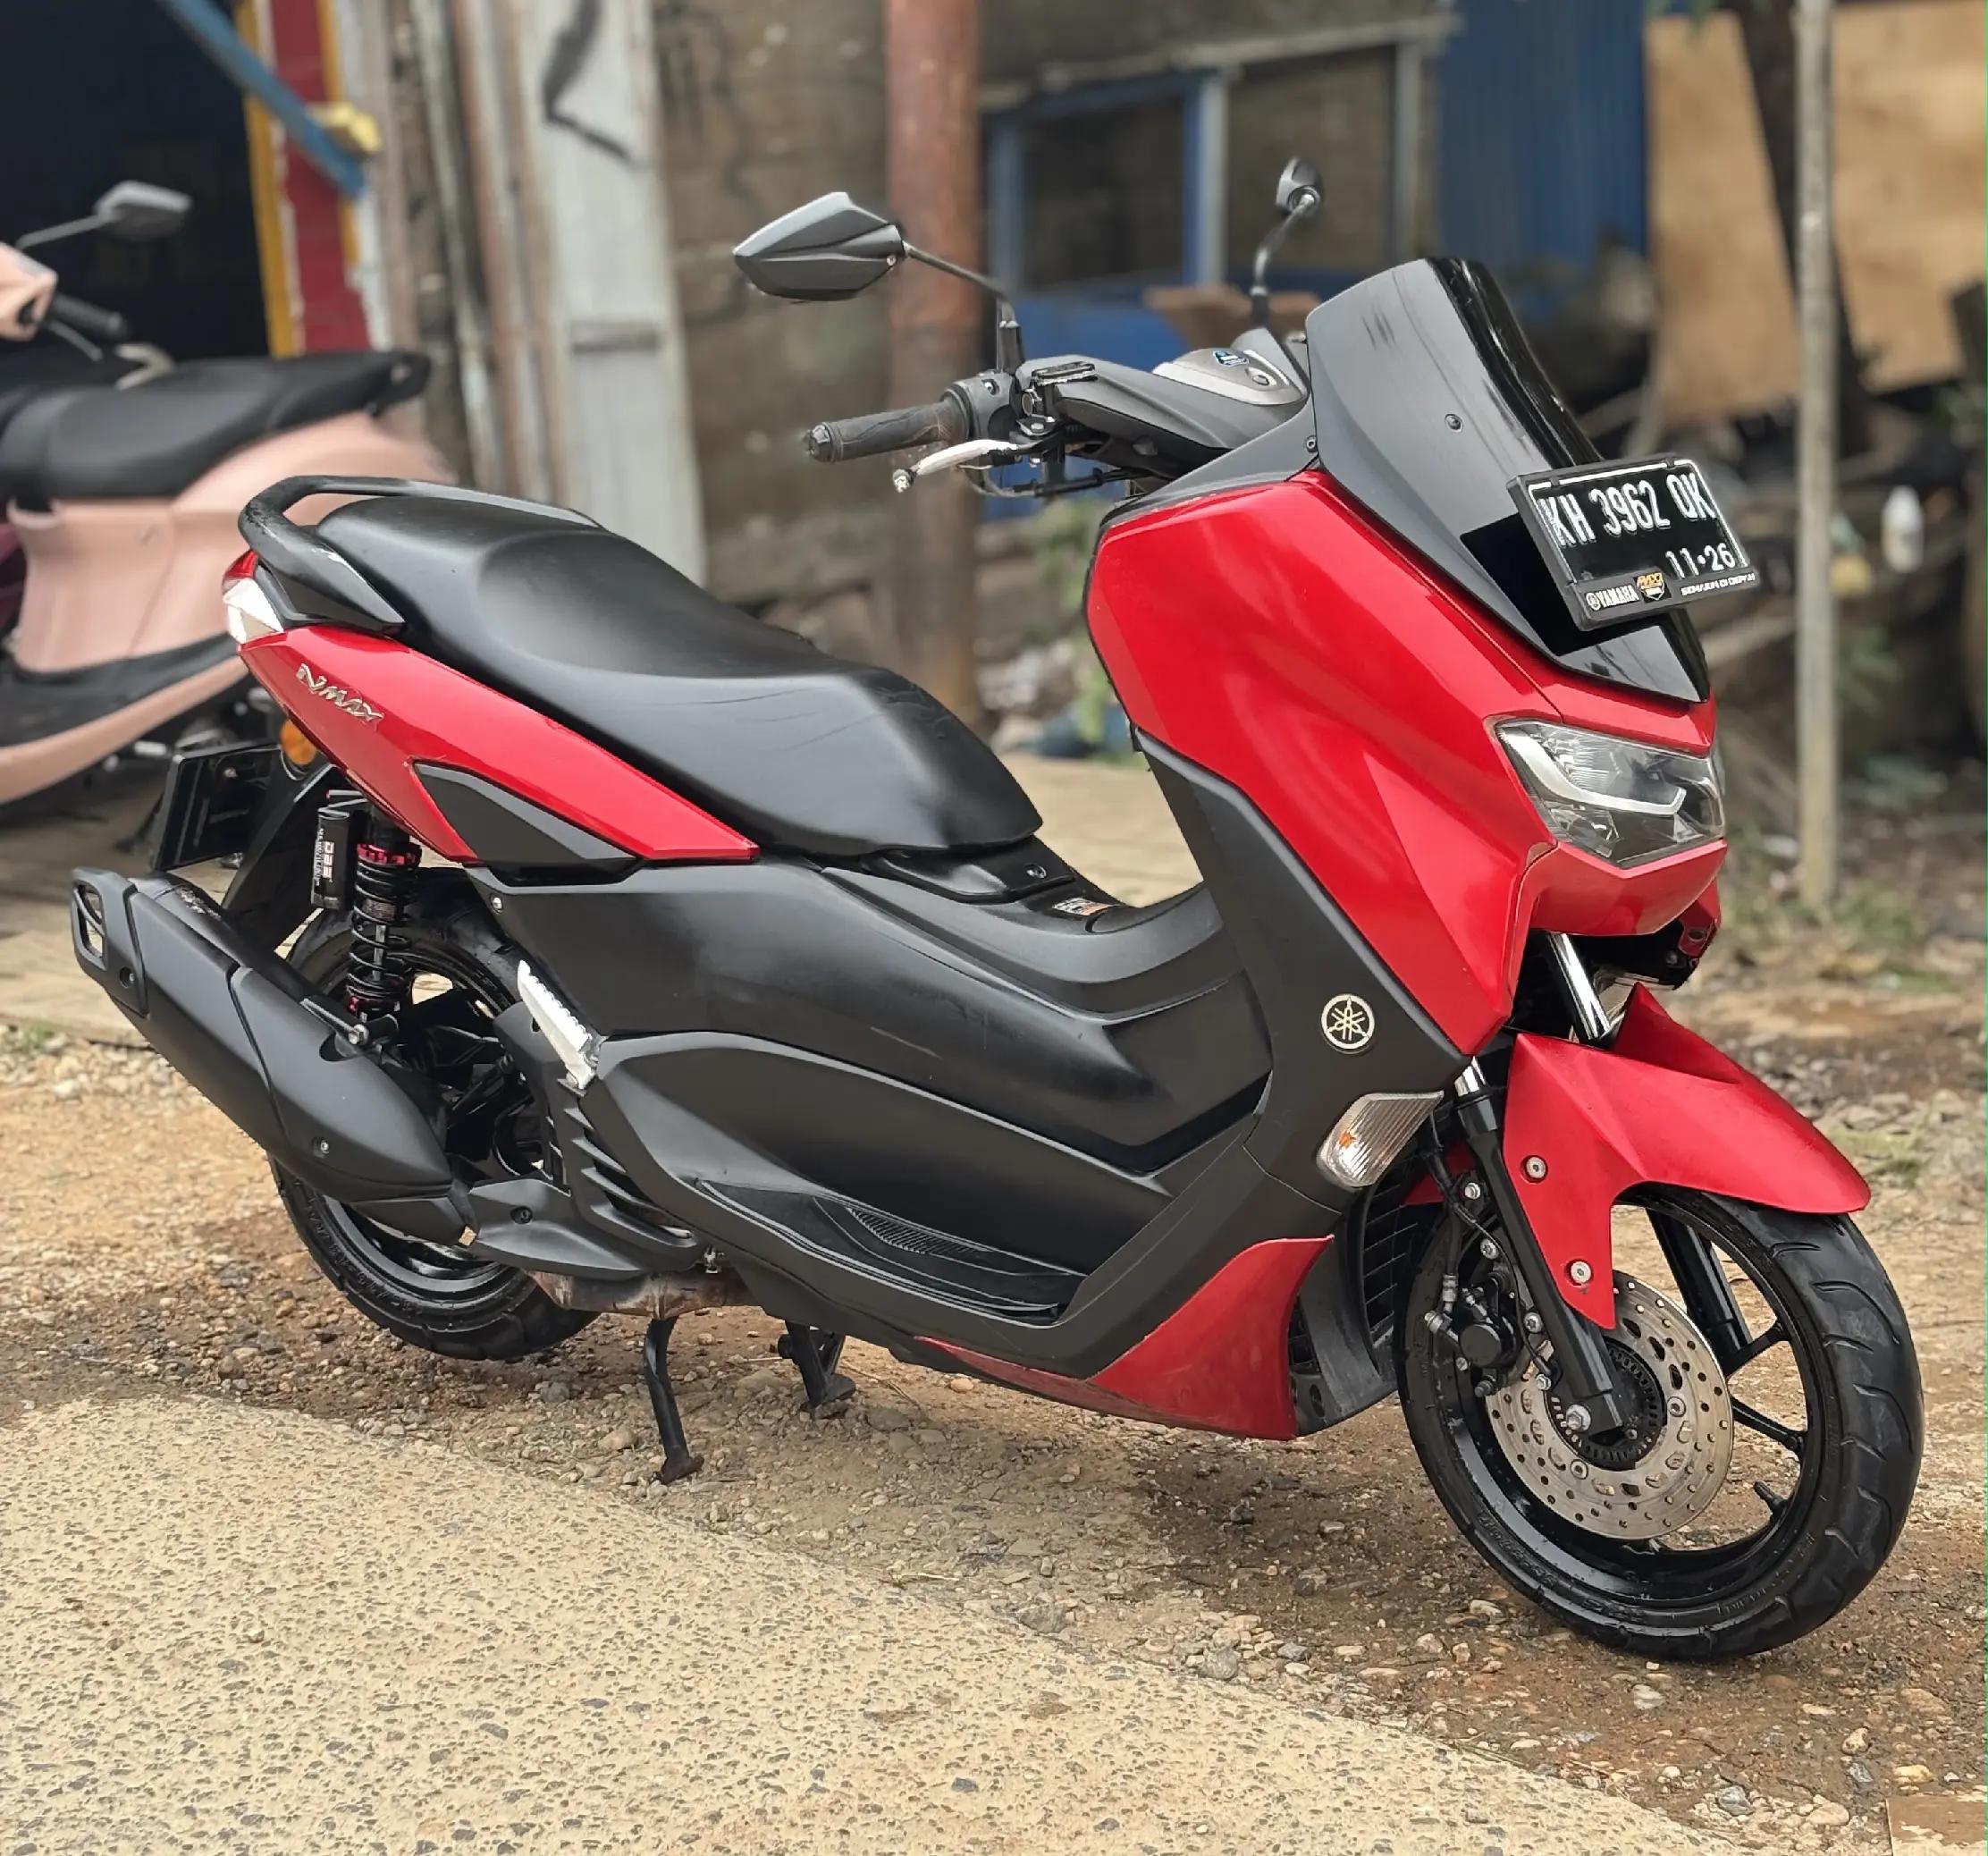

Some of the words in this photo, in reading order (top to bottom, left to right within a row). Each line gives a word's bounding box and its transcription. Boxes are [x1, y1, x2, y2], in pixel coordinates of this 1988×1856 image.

[1537, 494, 1596, 546] KH
[1589, 480, 1671, 536] 3962
[1595, 585, 1639, 607] YAMAHA
